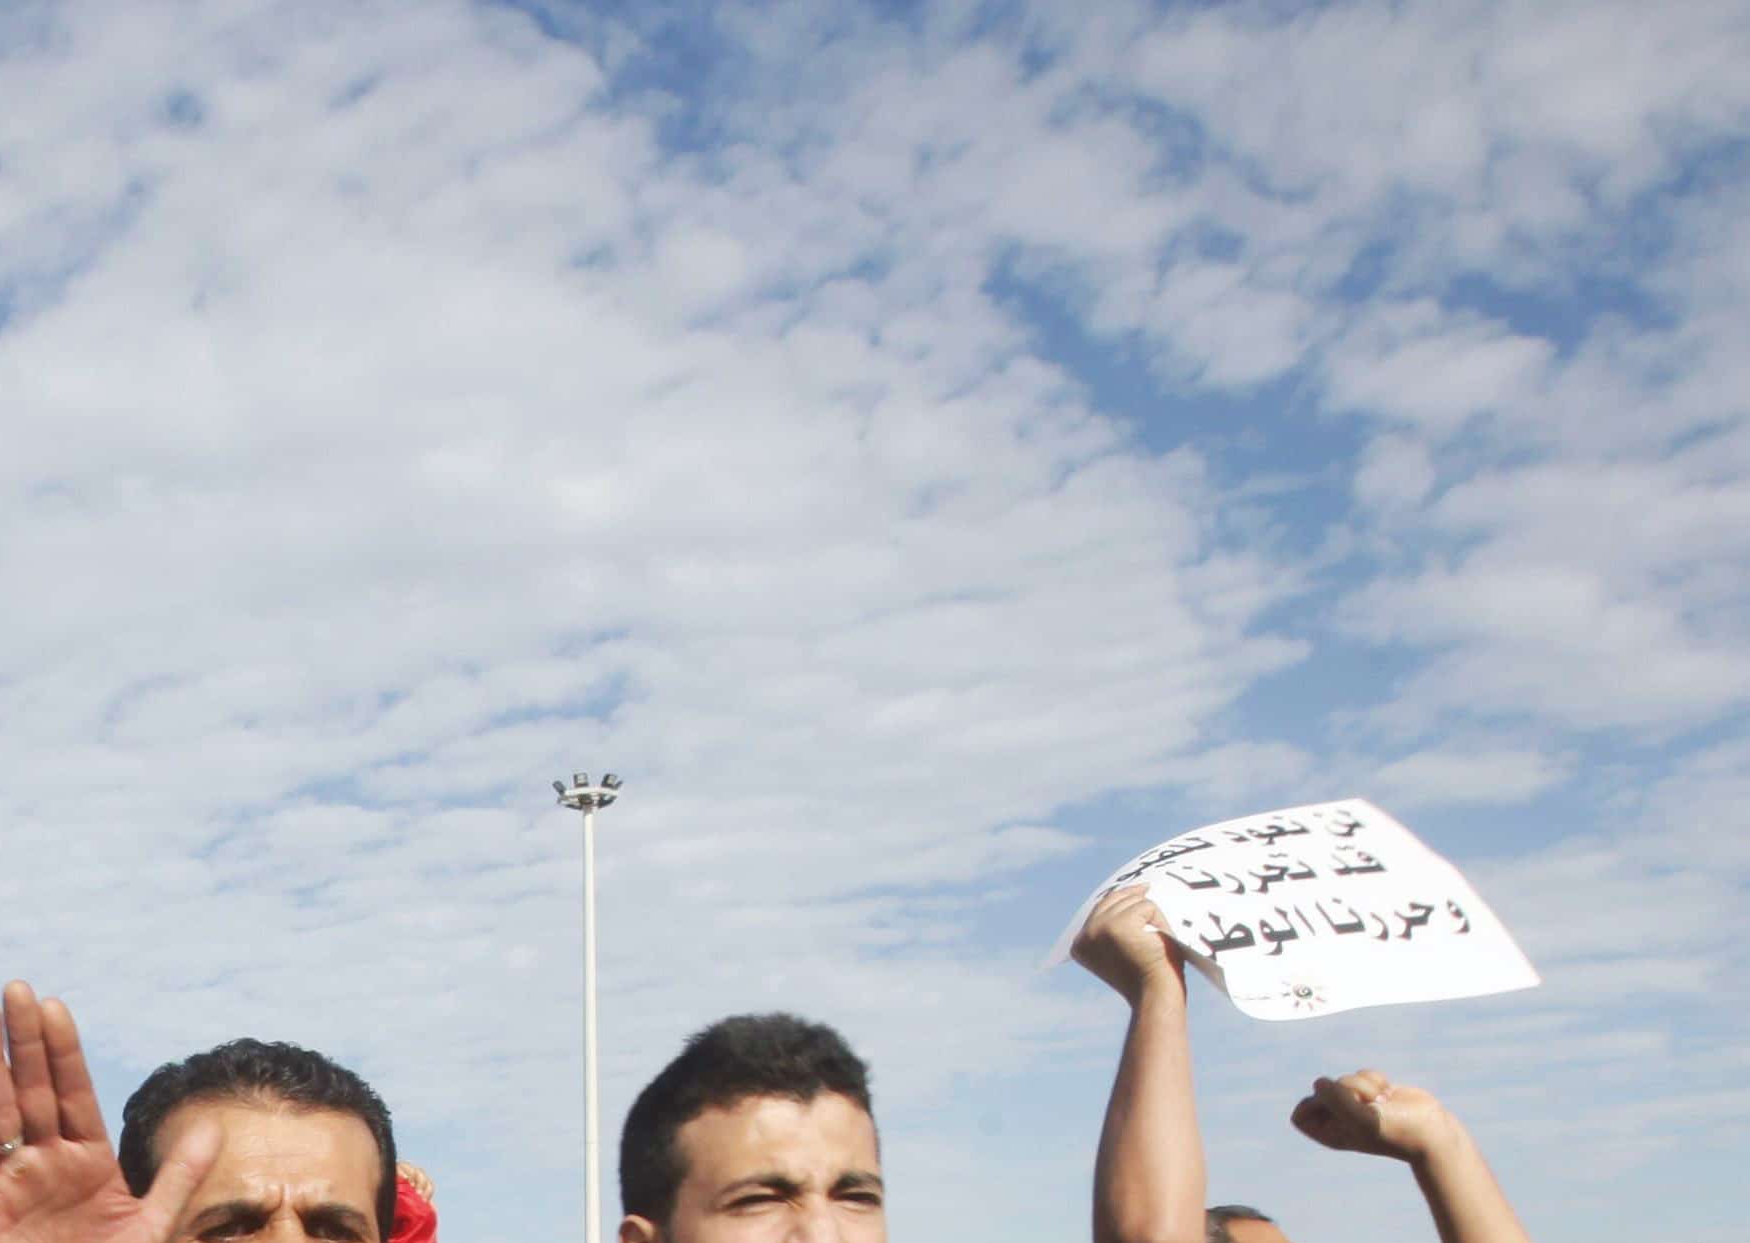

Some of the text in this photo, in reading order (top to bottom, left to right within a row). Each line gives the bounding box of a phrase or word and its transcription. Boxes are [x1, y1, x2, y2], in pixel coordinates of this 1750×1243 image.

[1222, 815, 1311, 845] نعود
[1165, 845, 1388, 895] قد تحررنا
[1181, 903, 1317, 960] الوطن
